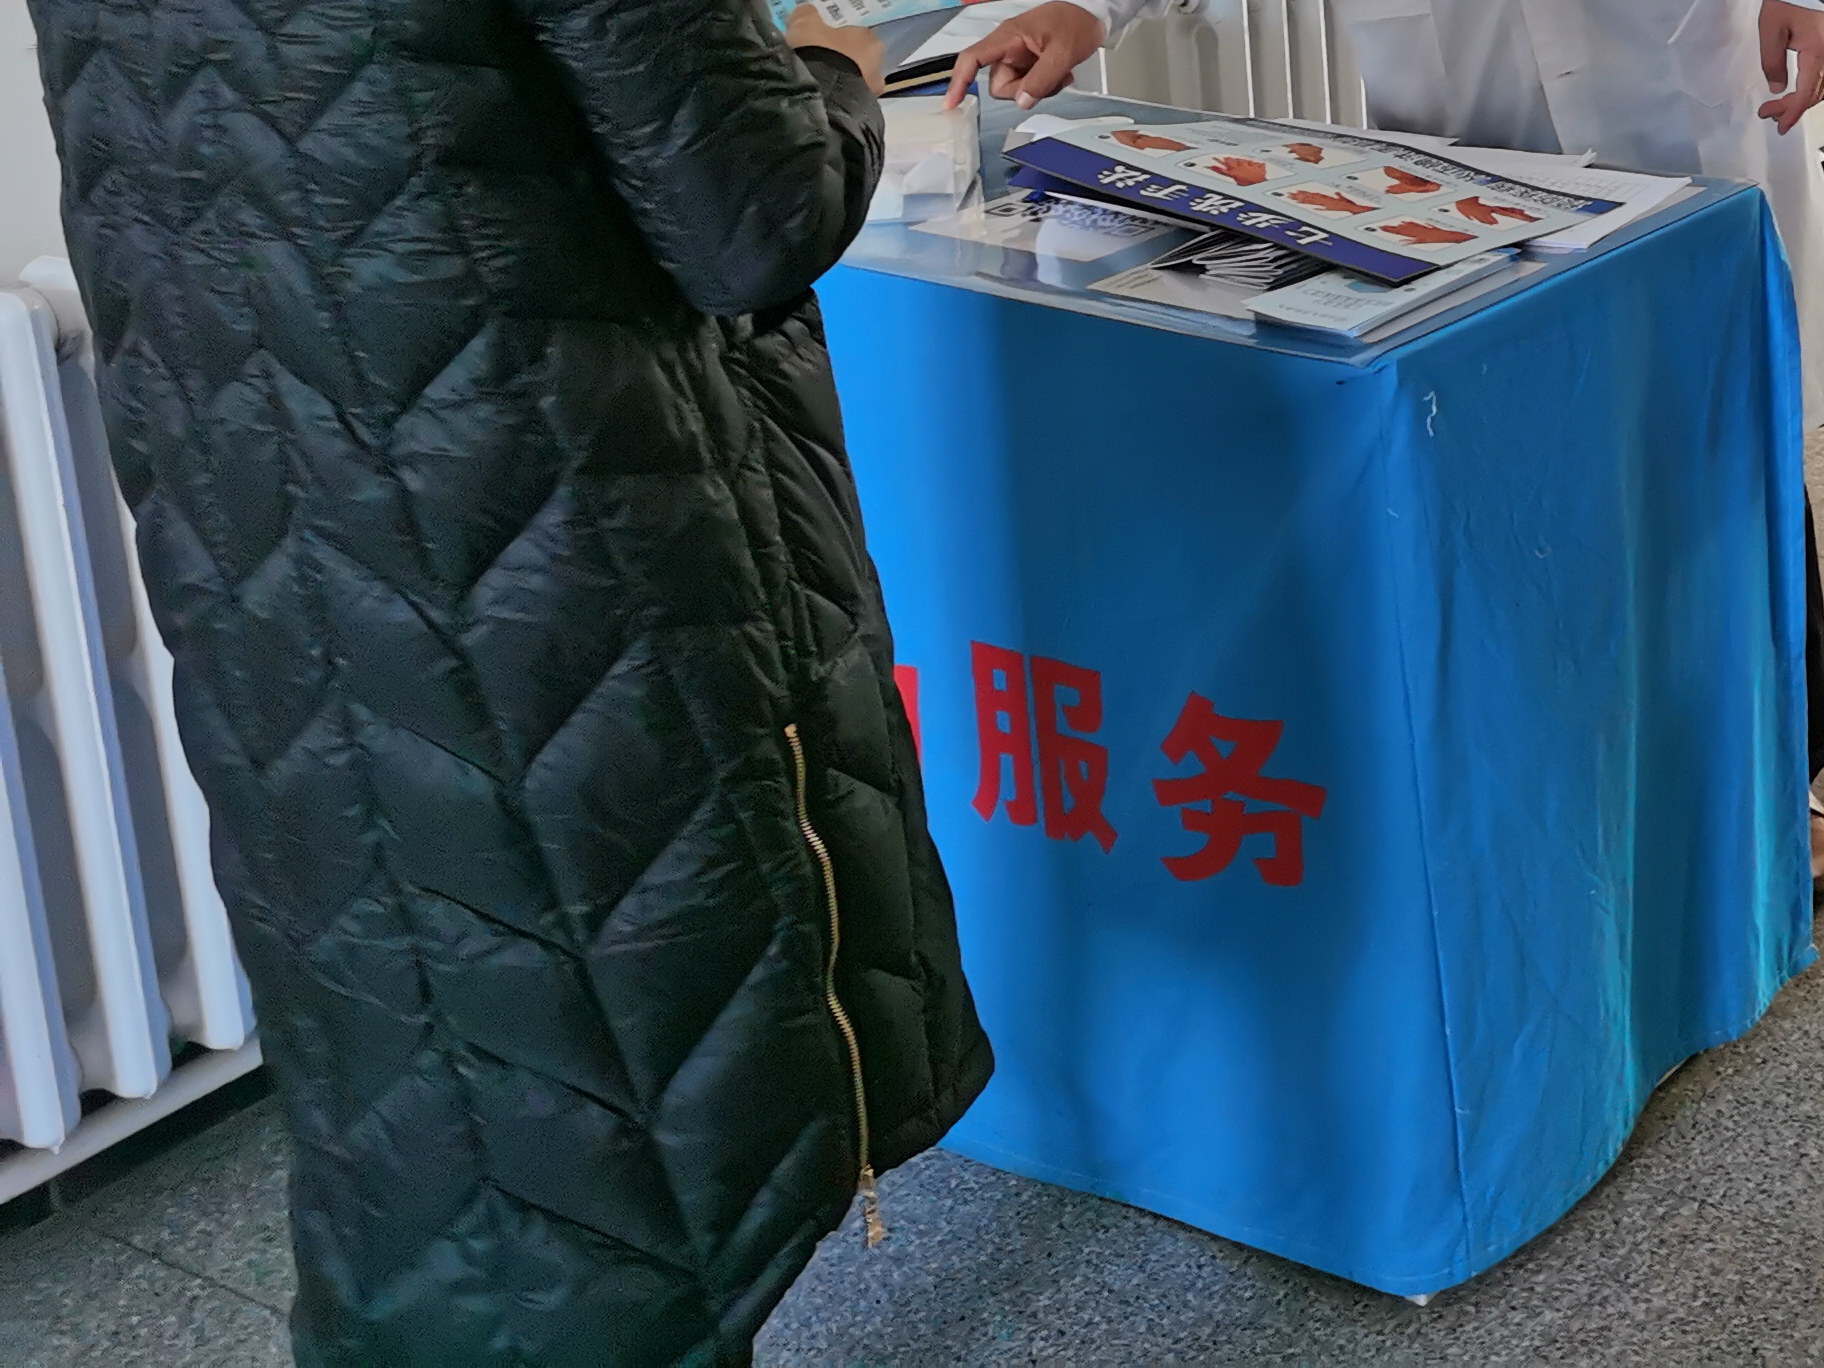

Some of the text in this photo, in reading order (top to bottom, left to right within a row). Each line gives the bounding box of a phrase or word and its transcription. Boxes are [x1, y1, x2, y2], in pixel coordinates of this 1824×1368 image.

[1097, 154, 1333, 246] 七步洗手法
[893, 639, 1327, 888] 服务
